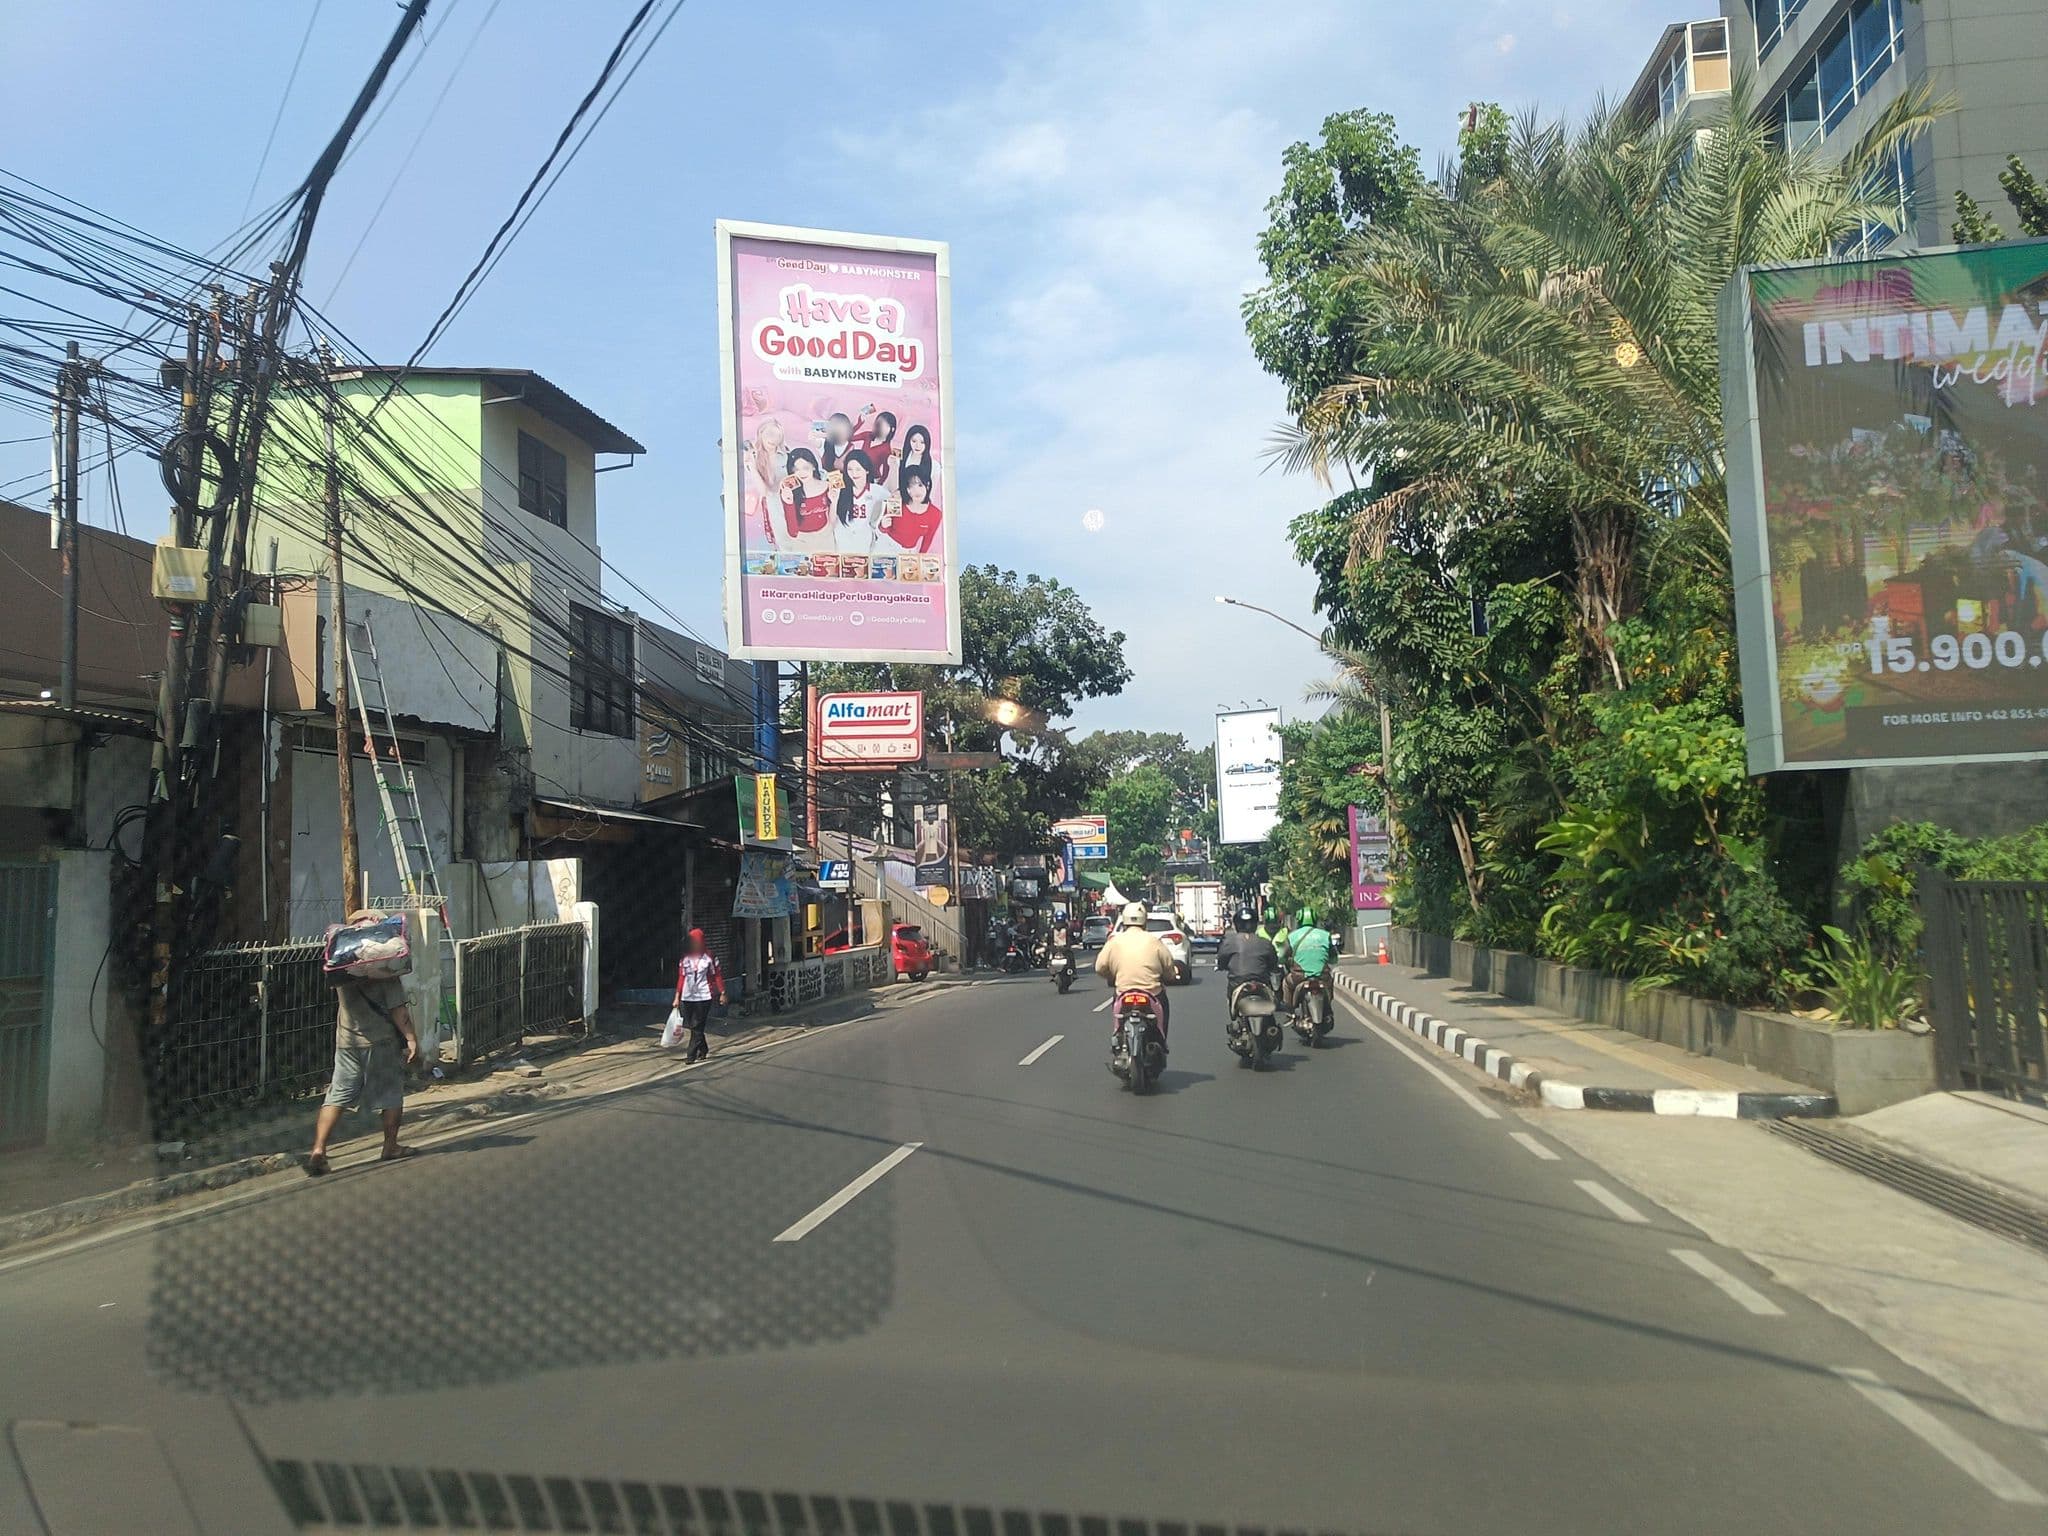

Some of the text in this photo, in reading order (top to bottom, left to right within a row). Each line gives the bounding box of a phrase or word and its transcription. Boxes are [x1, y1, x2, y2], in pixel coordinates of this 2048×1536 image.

[841, 265, 921, 281] BABYMONSTER
[787, 290, 898, 333] Have a
[1803, 300, 2048, 366] INTIMA
[779, 366, 897, 383] with BABYMONSTER
[761, 589, 930, 605] #KarenaHidupPerluBanyakRasa
[1866, 631, 2048, 675] 15.900.
[828, 702, 912, 718] Alfamart
[1883, 714, 1909, 726] FOR
[1911, 713, 1949, 725] MORE
[1951, 711, 1983, 722] INFO
[1985, 709, 2008, 720] +62
[763, 781, 771, 837] LAUNDRY
[1360, 892, 1372, 901] IN
